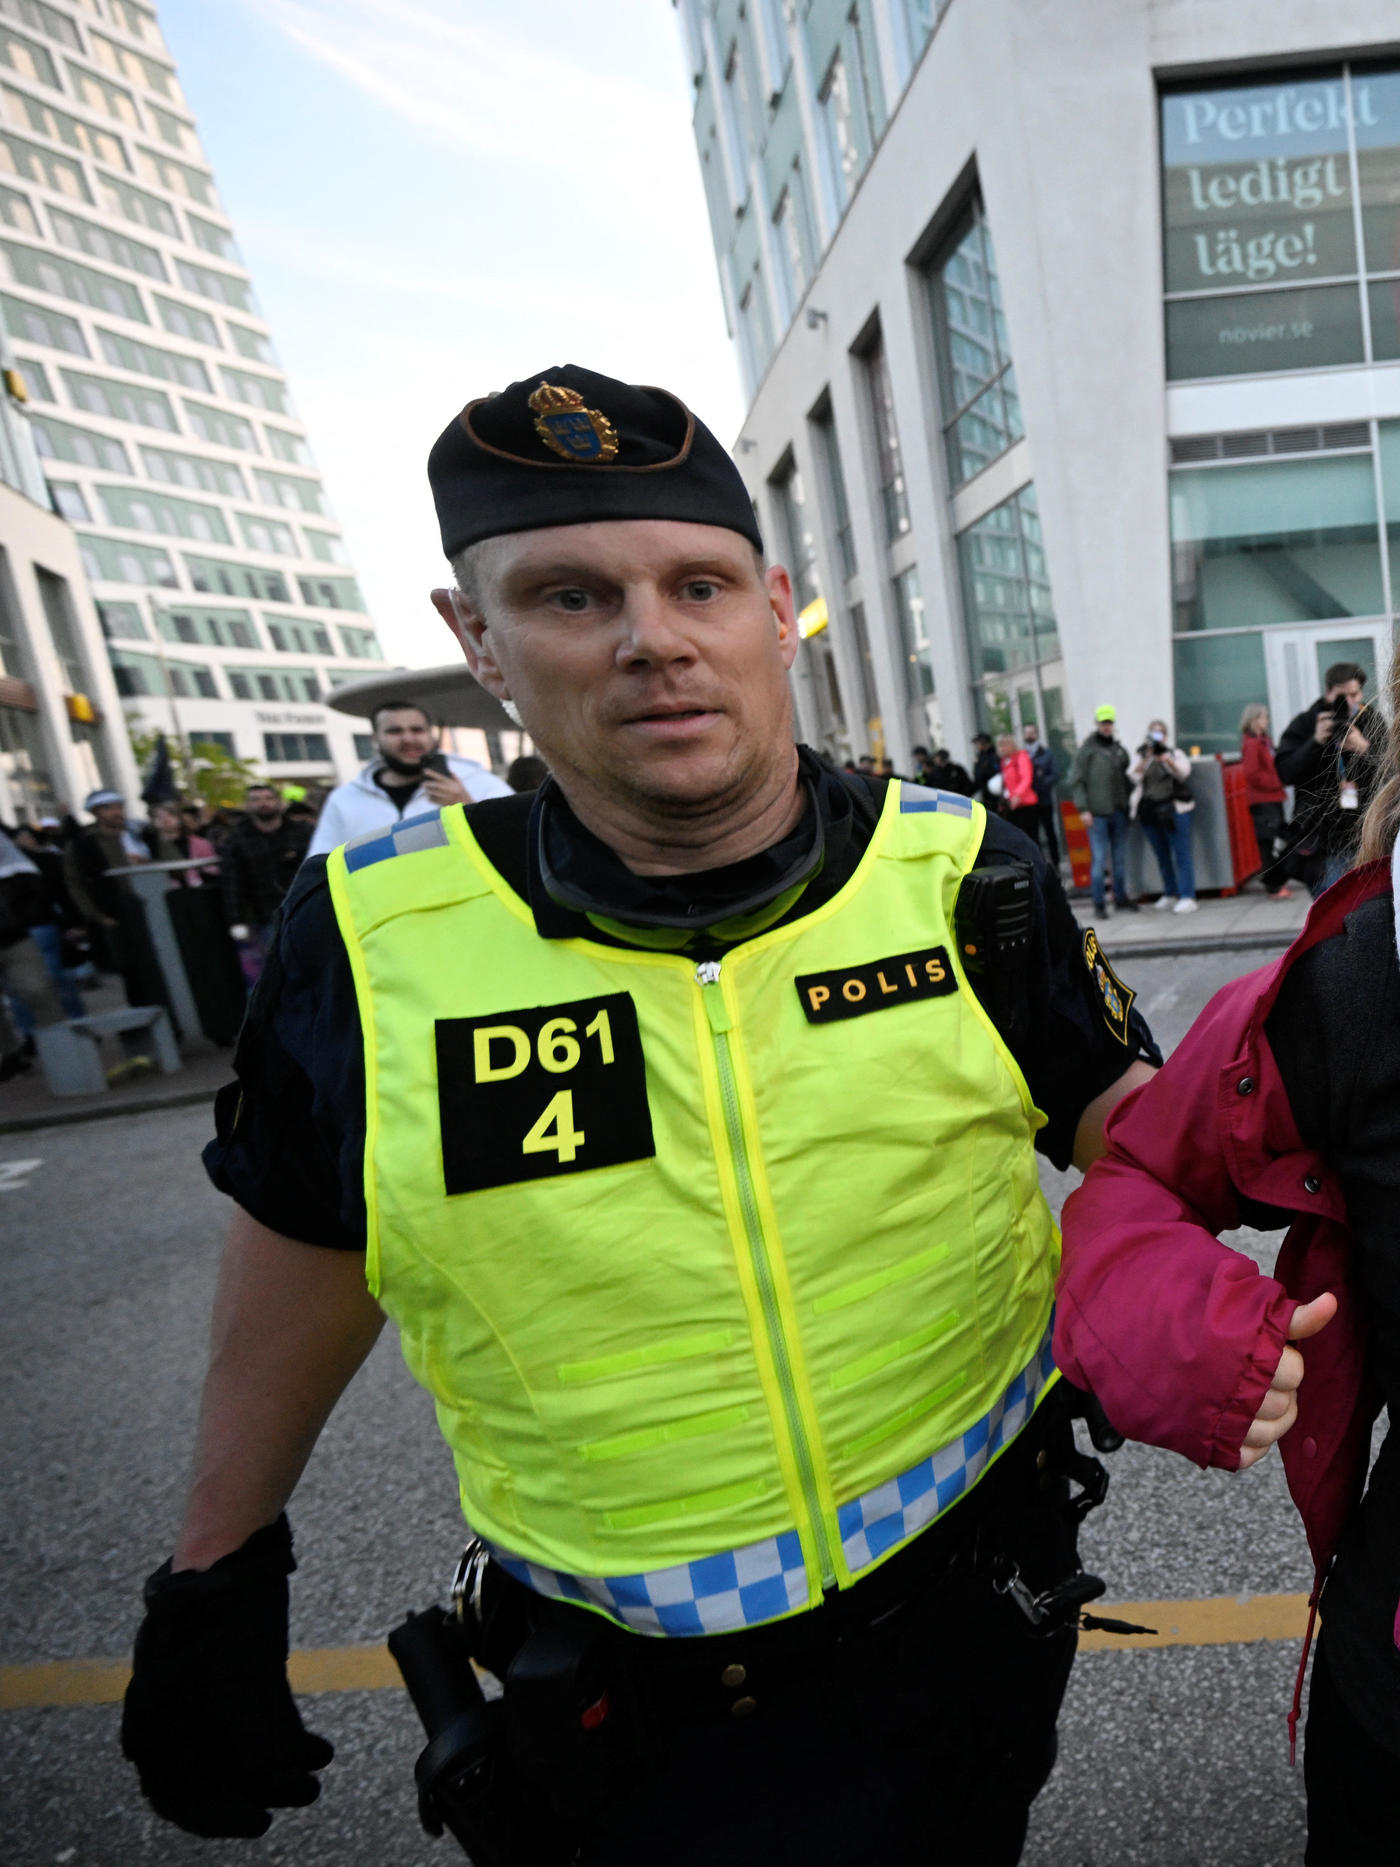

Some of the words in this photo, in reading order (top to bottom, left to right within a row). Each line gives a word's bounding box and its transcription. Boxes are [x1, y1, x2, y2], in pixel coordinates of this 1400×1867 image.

[1183, 86, 1379, 144] Perfekt
[1188, 155, 1346, 211] ledigt
[1194, 222, 1318, 281] läge!
[807, 958, 946, 1011] POLIS
[473, 1009, 614, 1083] D61
[522, 1089, 585, 1163] 4
